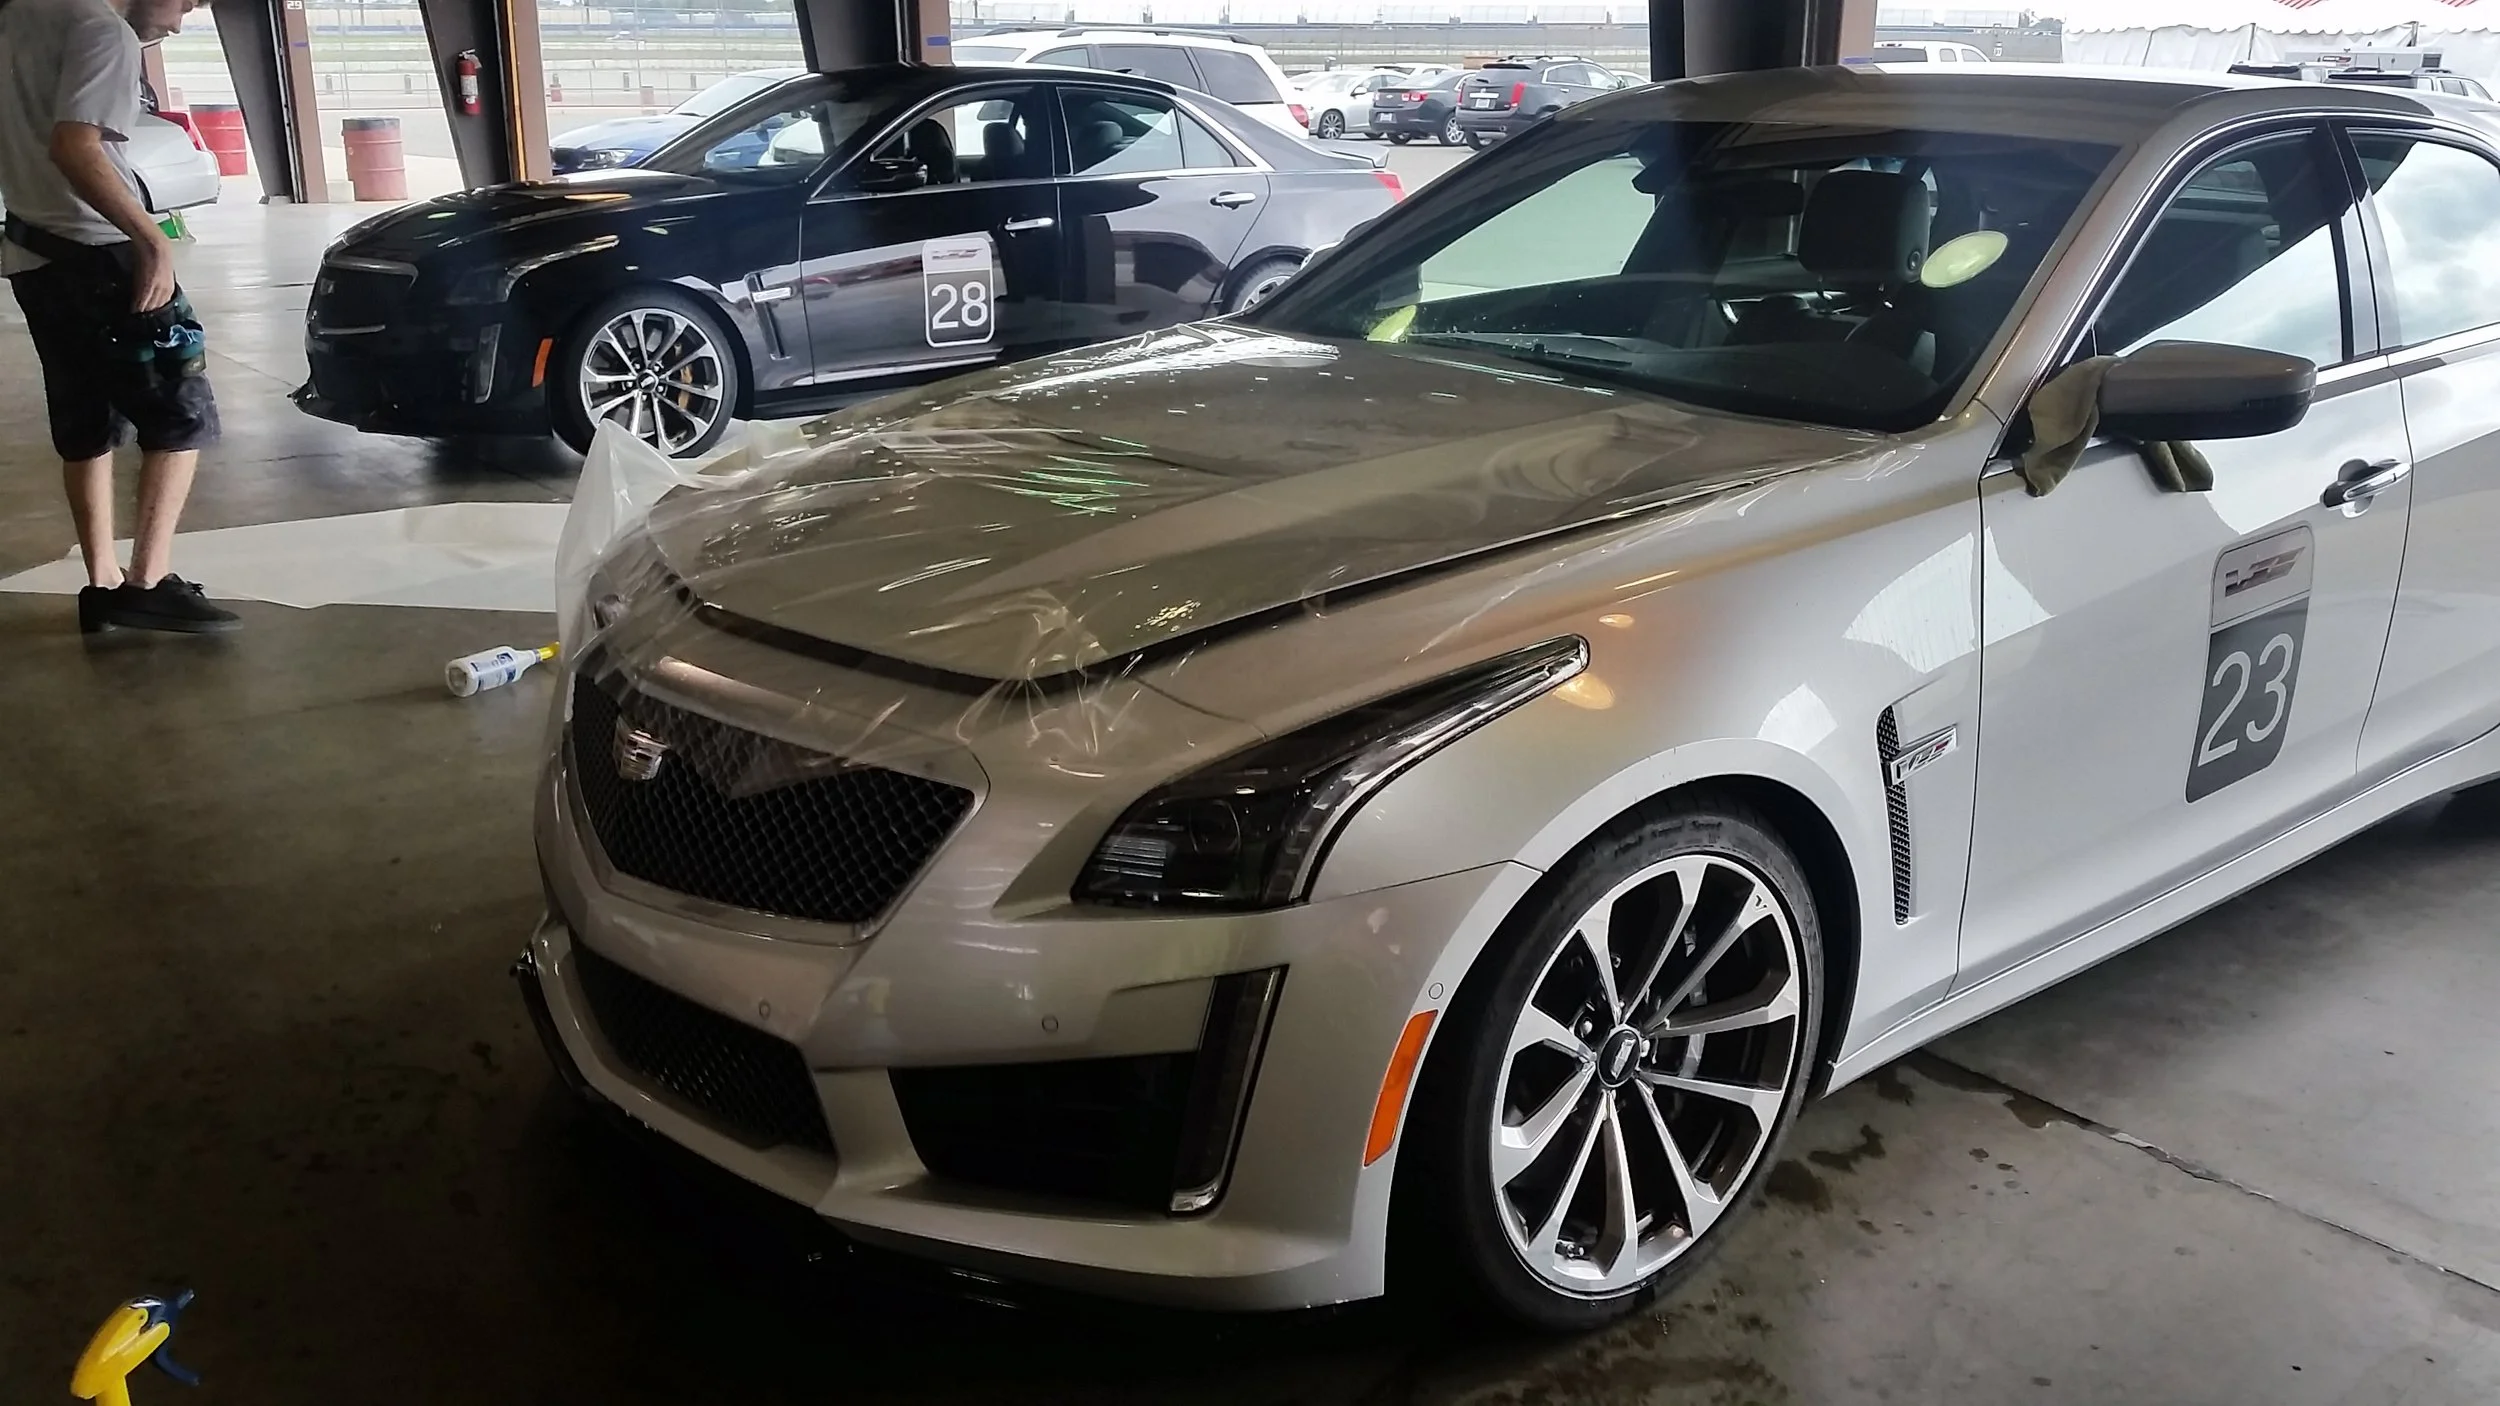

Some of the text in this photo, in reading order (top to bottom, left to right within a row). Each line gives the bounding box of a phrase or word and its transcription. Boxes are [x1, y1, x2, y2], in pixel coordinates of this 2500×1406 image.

[287, 0, 303, 10] 29
[931, 281, 988, 330] 28
[2198, 633, 2295, 767] 23
